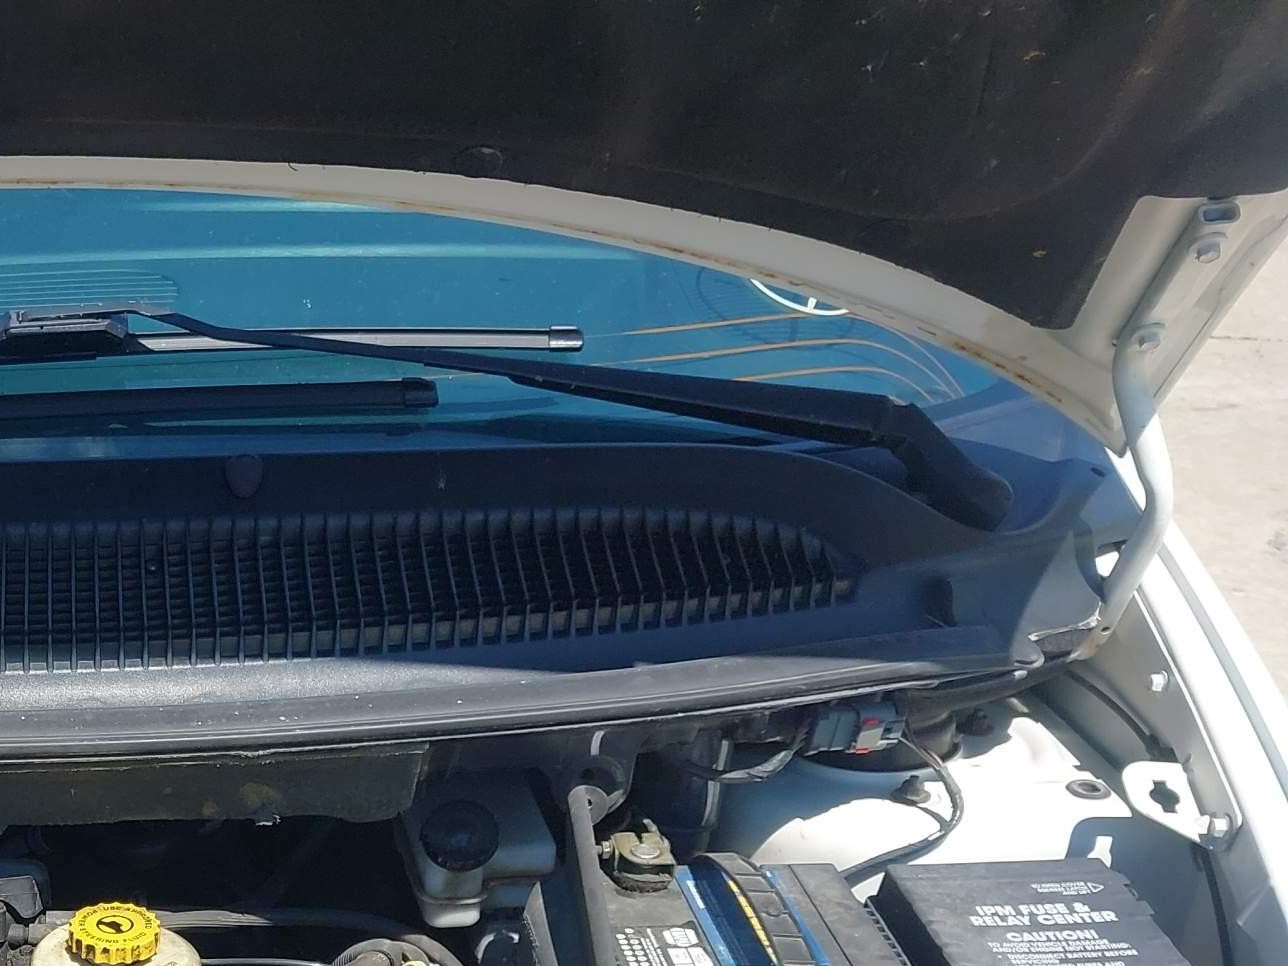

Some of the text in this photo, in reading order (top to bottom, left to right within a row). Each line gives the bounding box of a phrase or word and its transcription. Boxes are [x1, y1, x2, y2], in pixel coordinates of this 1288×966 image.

[975, 902, 1091, 916] IPM FUSE &
[968, 910, 1120, 927] RELAY CENTER
[1006, 929, 1099, 942] CAUTION!
